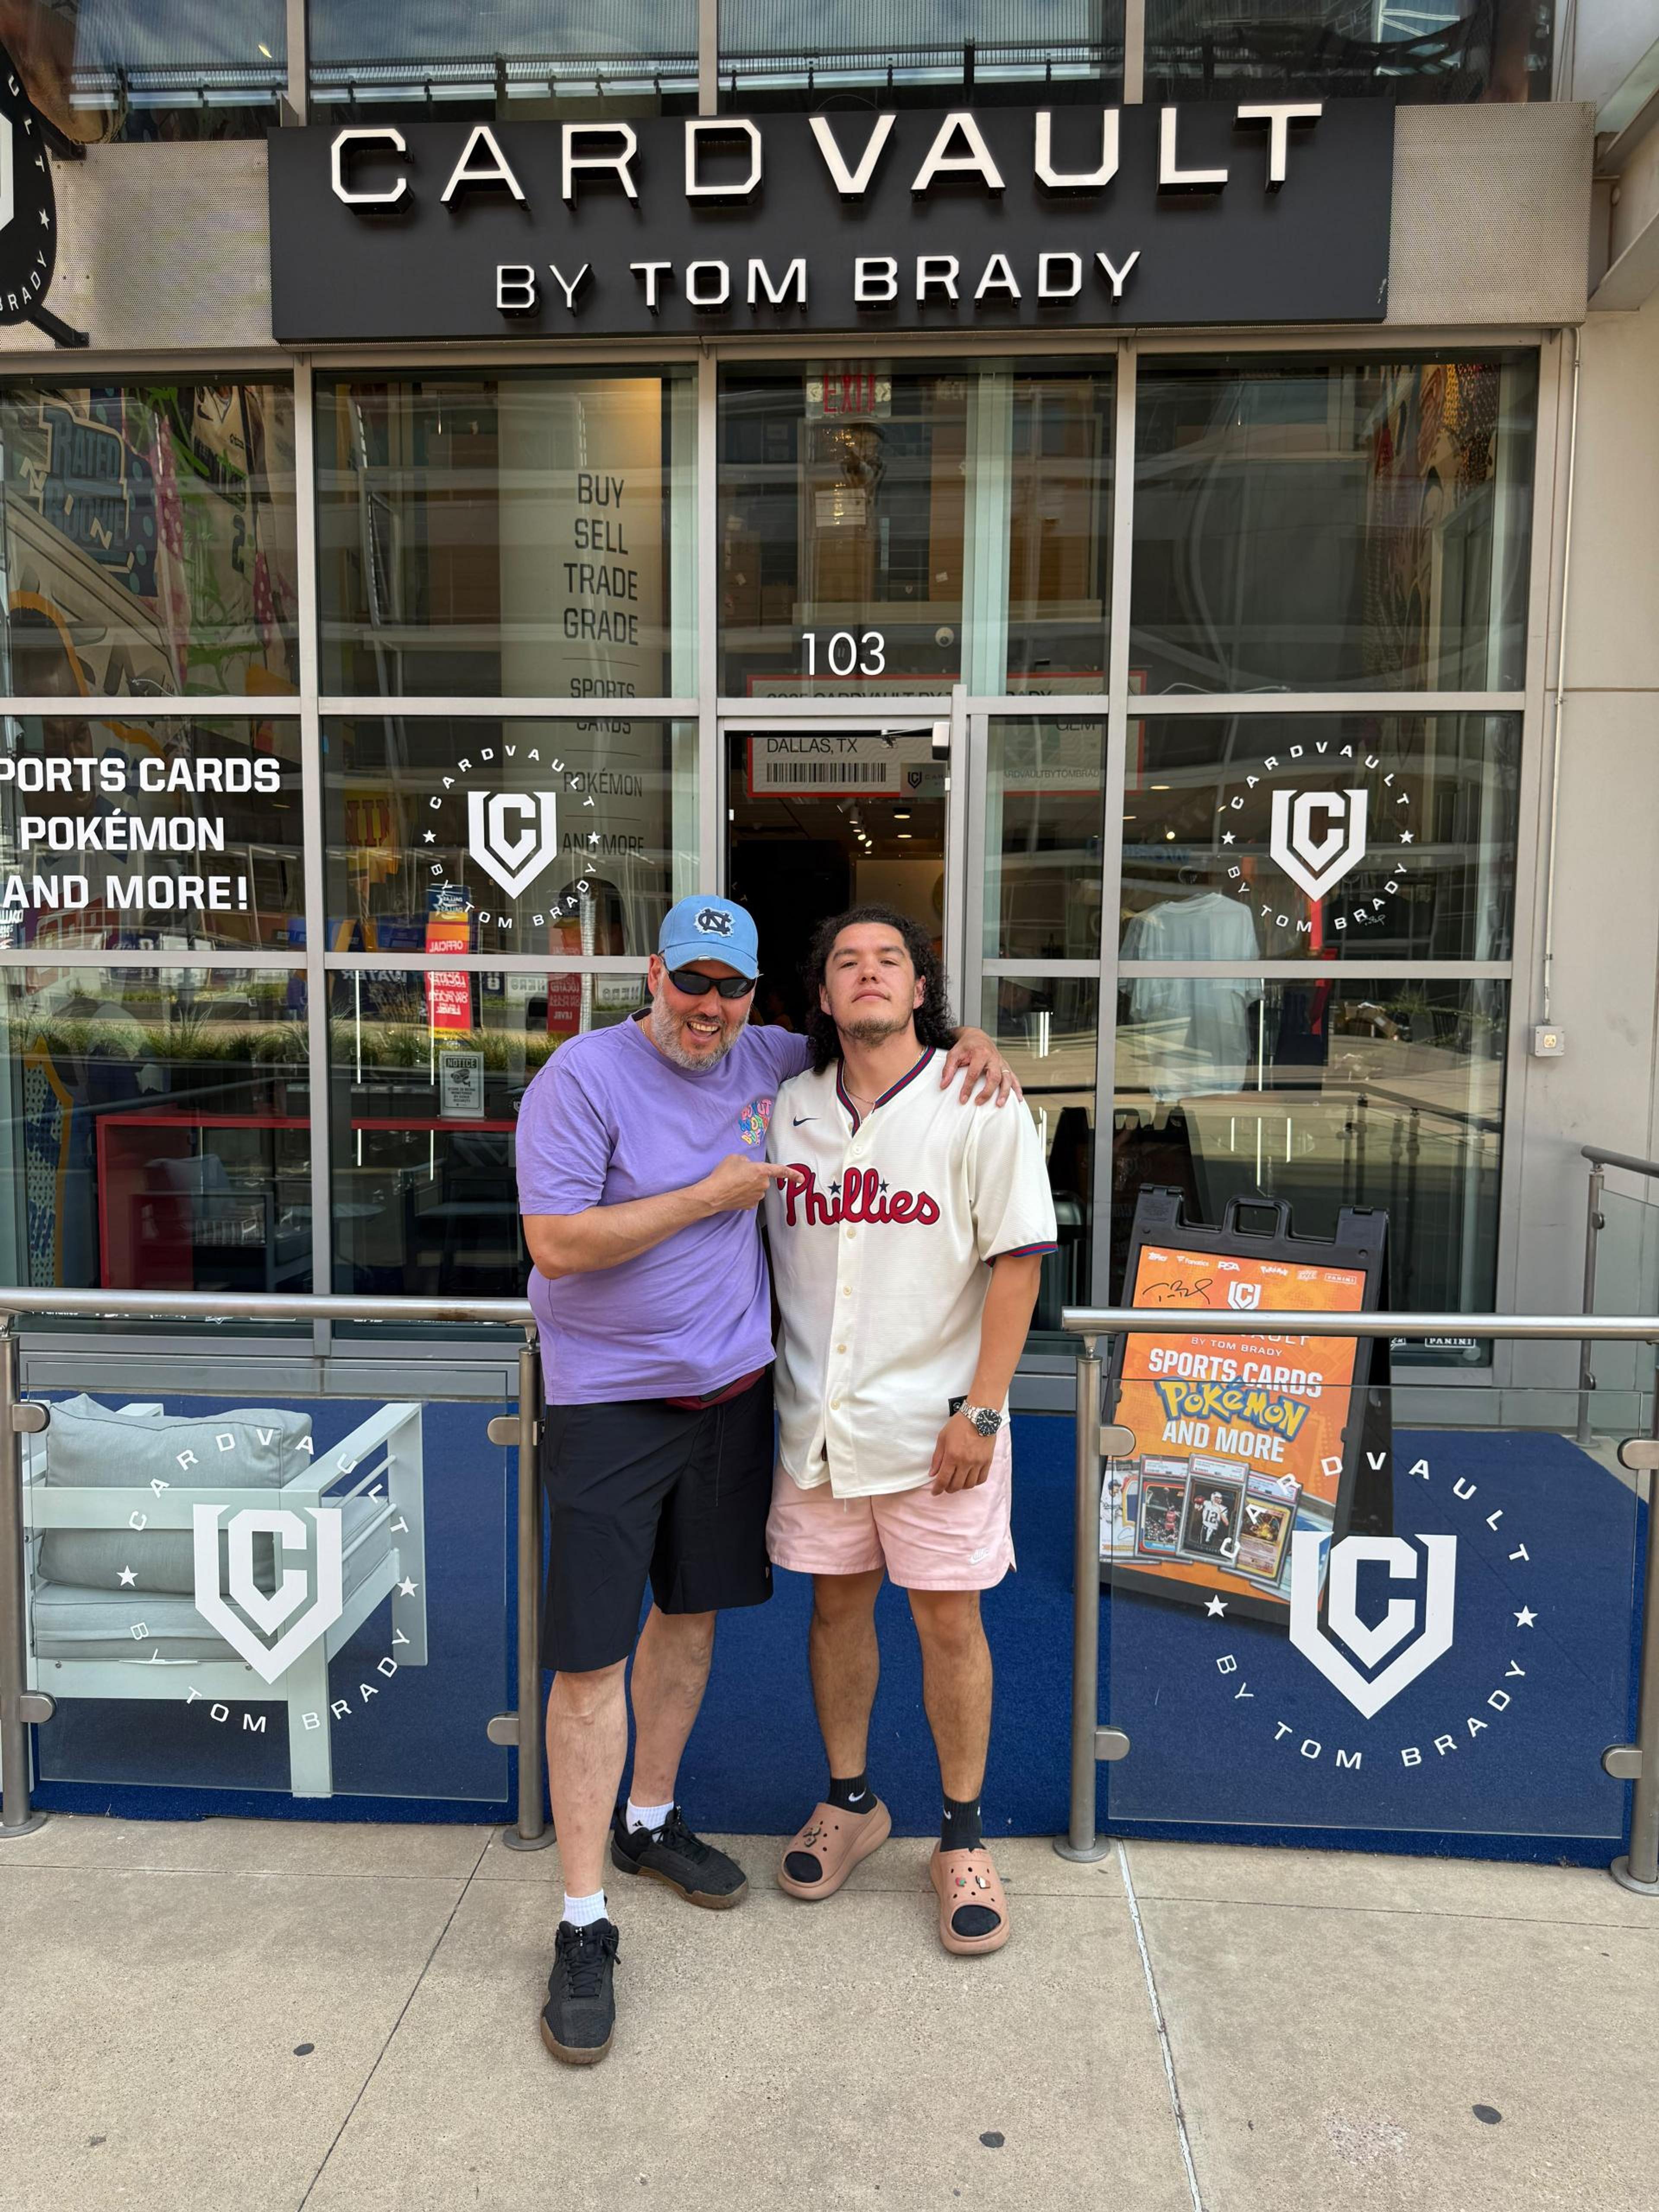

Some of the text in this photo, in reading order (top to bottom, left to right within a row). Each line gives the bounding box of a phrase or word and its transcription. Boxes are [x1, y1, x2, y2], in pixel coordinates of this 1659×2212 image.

[331, 103, 1322, 203] CARDVAULT
[496, 251, 1141, 308] BY TOM BRADY
[578, 474, 625, 509] BUY
[574, 518, 629, 555] SELL
[563, 563, 638, 601] TRADE
[563, 607, 639, 646] GRADE
[802, 631, 886, 676] 103
[570, 678, 635, 698] SPORTS
[836, 738, 858, 753] TX
[0, 757, 280, 792] PORTS CARDS
[429, 745, 594, 810] CARDVAULT
[563, 768, 643, 798] POKÉMON
[1231, 741, 1410, 810] CARDVAULT
[21, 808, 225, 851] POKÉMON
[3, 875, 247, 910] AND MORE!
[431, 863, 597, 929] BY TOM BRADY
[1227, 866, 1250, 895] BY
[1261, 904, 1312, 933] TOM
[1334, 862, 1408, 931] BRADY
[447, 1058, 477, 1068] NOTICE
[777, 1163, 940, 1227] Phillies
[1217, 1261, 1240, 1271] PSA
[1191, 1336, 1206, 1345] BY
[1211, 1339, 1236, 1351] TOM
[1240, 1344, 1283, 1357] BRADY
[1148, 1348, 1323, 1398] SPORTS CARDS
[1162, 1421, 1286, 1464] AND MORE
[129, 1429, 409, 1534] CARDVAULT
[1204, 1509, 1218, 1524] 12
[1219, 1452, 1530, 1564] CARDVAULT
[130, 1622, 411, 1733] BY TOM BRADY
[1216, 1654, 1526, 1770] BY TOM BRADY
